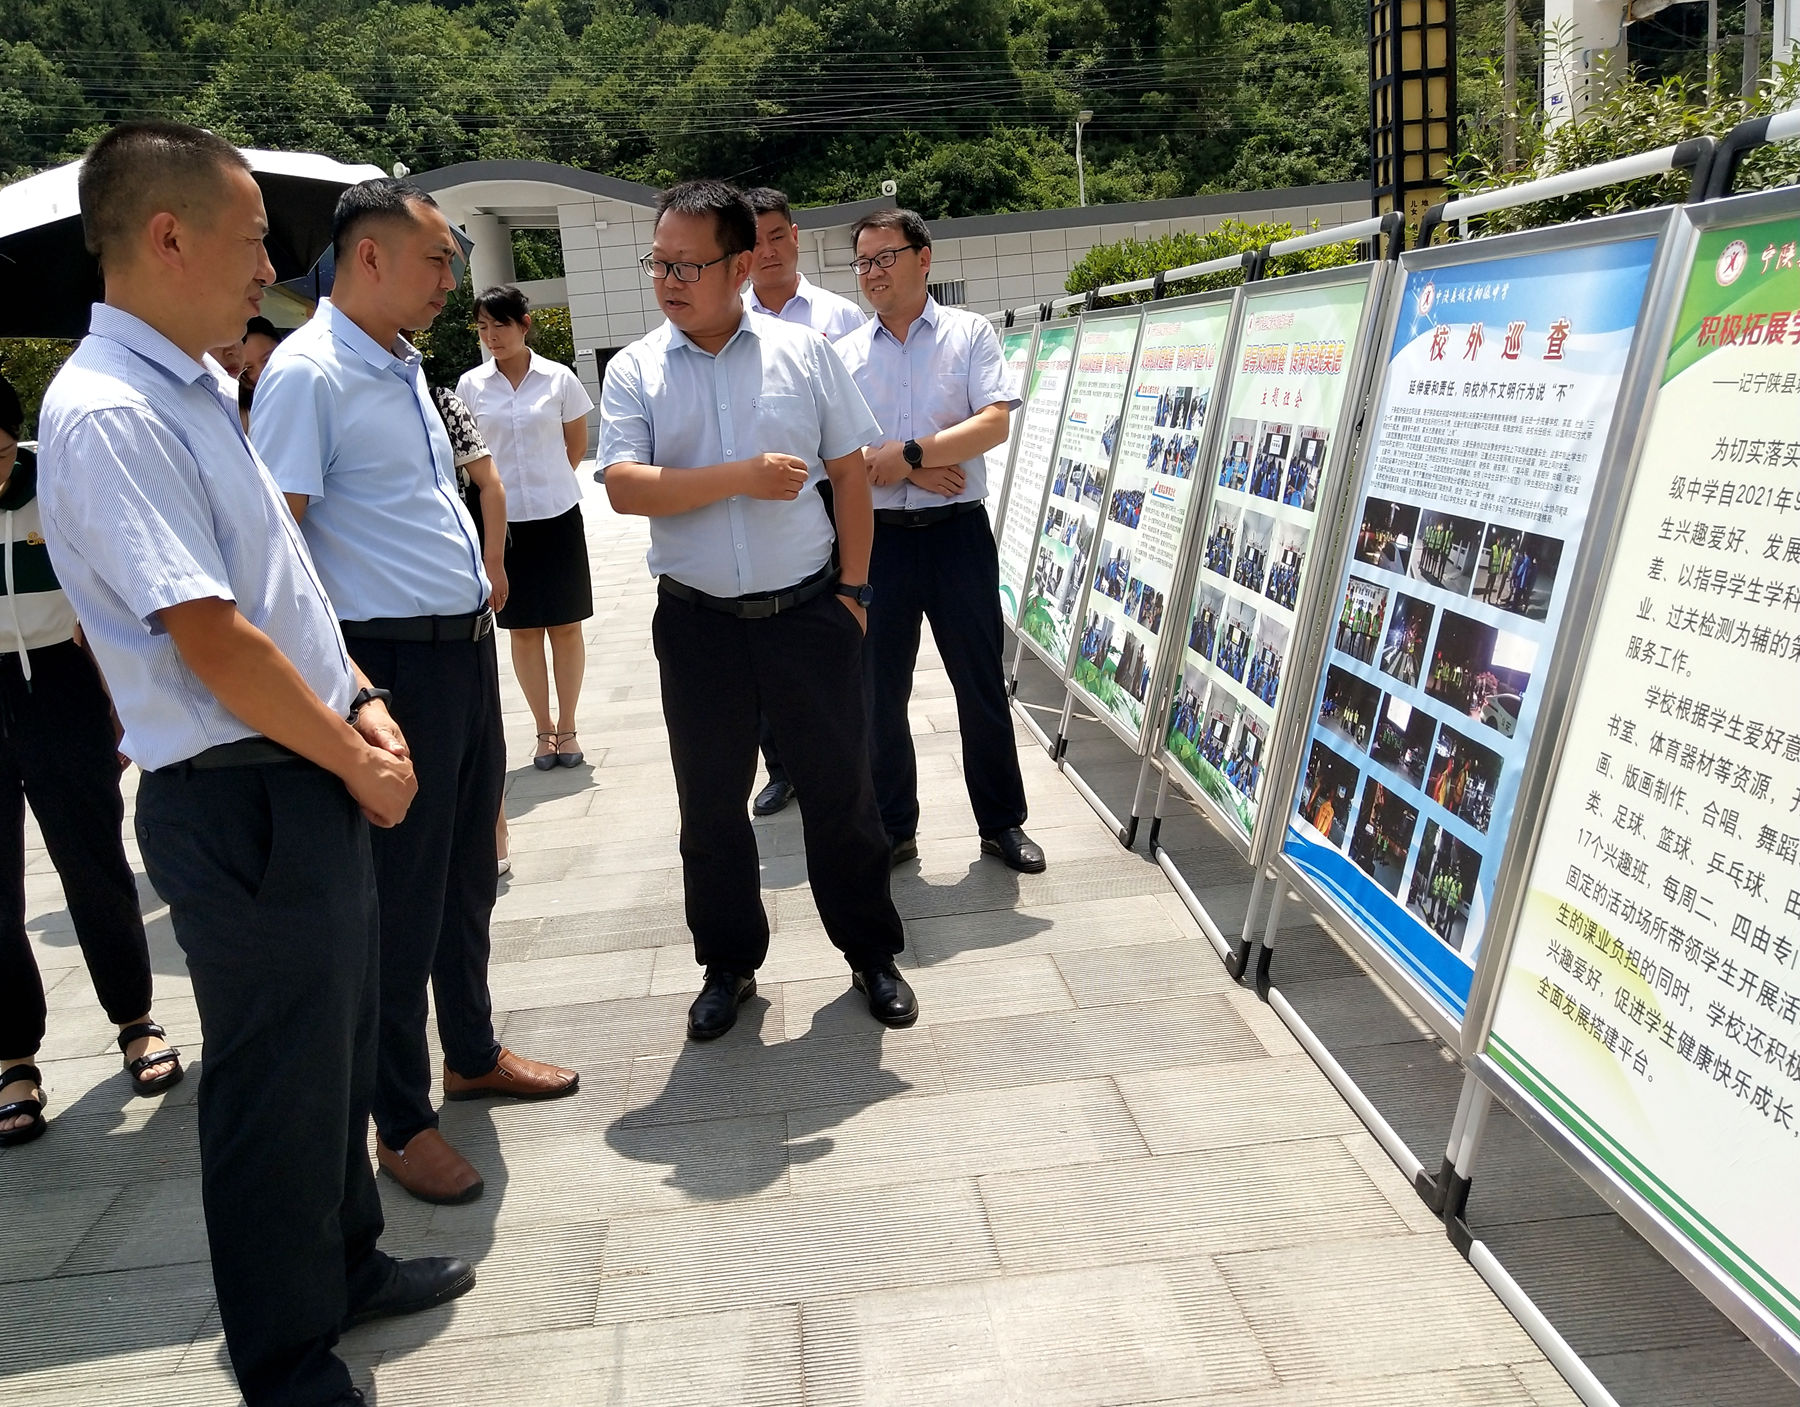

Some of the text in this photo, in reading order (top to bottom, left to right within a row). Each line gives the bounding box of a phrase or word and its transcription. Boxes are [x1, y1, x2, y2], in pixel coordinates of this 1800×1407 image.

[1761, 241, 1800, 276] 宁陕
[1429, 316, 1572, 363] 校外巡查
[1711, 436, 1800, 468] 为切实落实
[1658, 515, 1800, 565] 生兴趣爱好、发展
[1647, 555, 1800, 613] 差、以指导学生学科
[1625, 636, 1694, 679] 服务工作。
[1644, 684, 1800, 763] 学校根据学生爱好意
[1537, 976, 1654, 1084] 全面发展搭建平台。
